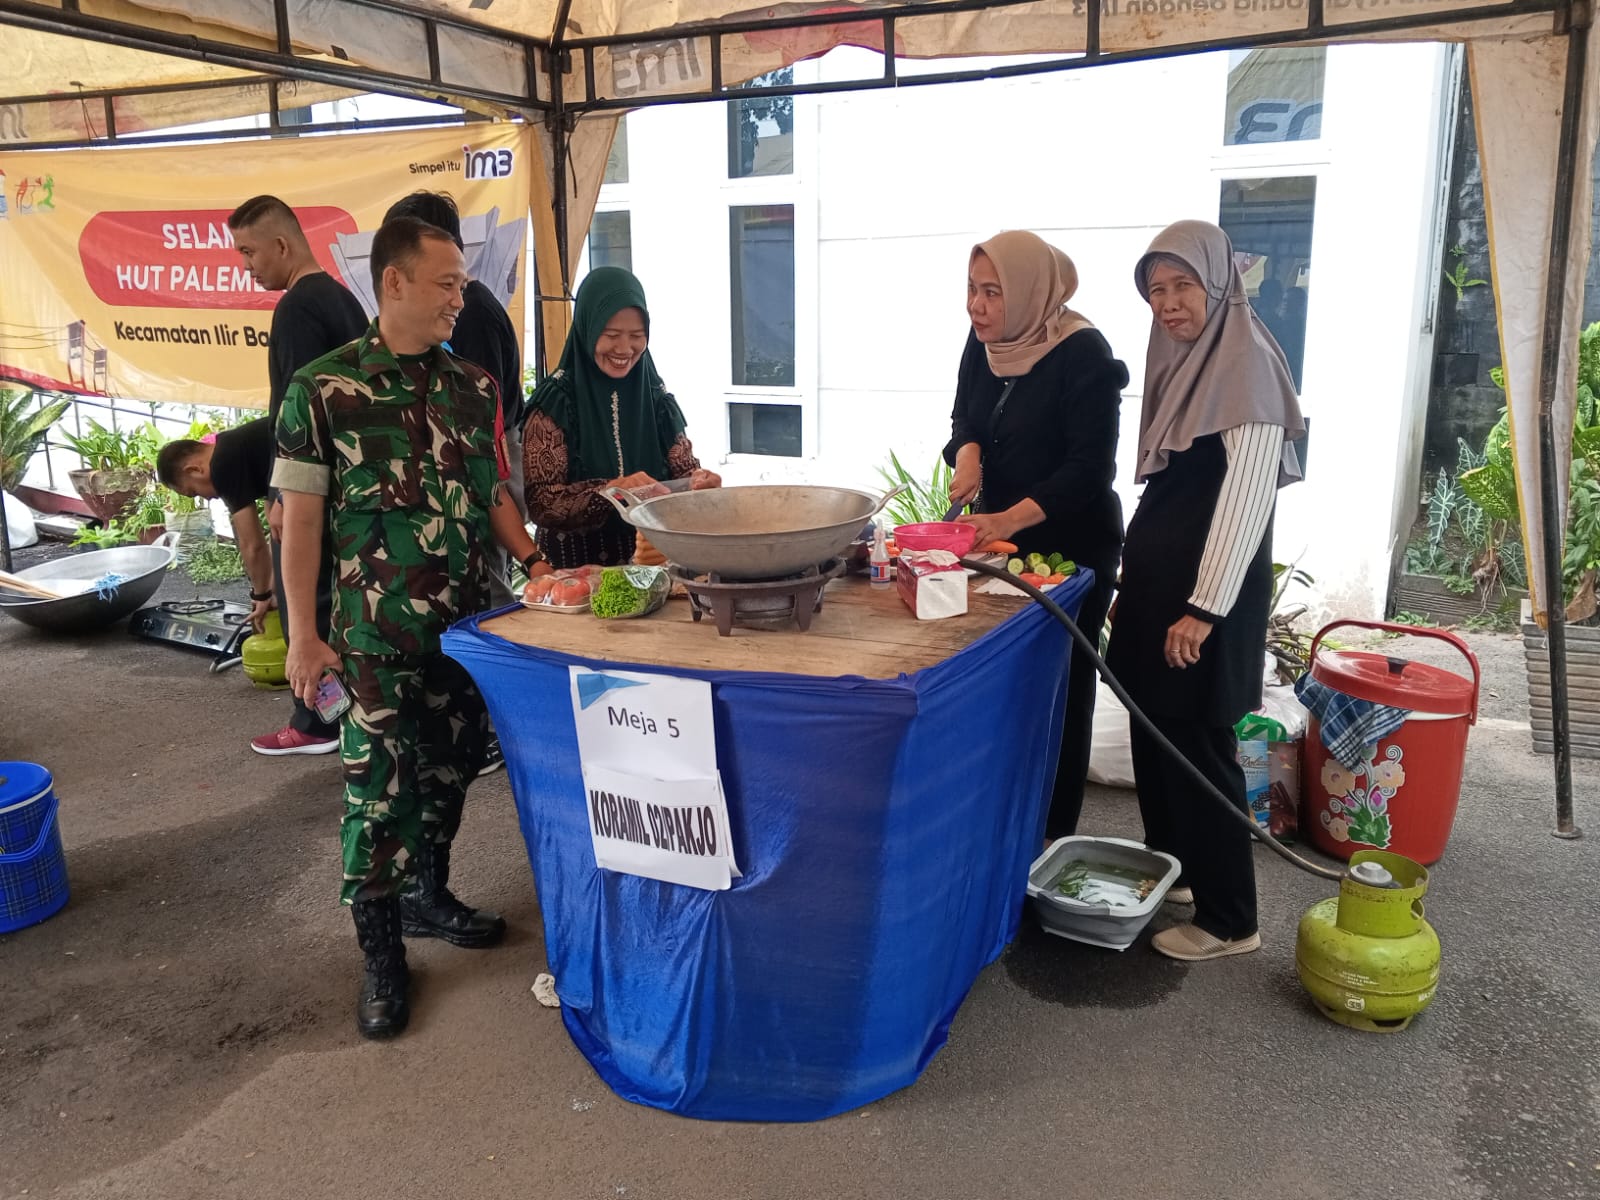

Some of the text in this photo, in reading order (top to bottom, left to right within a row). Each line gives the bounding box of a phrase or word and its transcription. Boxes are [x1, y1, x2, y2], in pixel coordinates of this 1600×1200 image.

[409, 161, 445, 175] Simpel
[447, 160, 460, 171] itu
[162, 222, 235, 249] SELAM
[116, 265, 266, 292] HUT PALEM
[114, 321, 270, 347] Kecamatan Ilir Ba
[608, 706, 680, 738] Meja 5
[589, 790, 651, 847] KORAMIL
